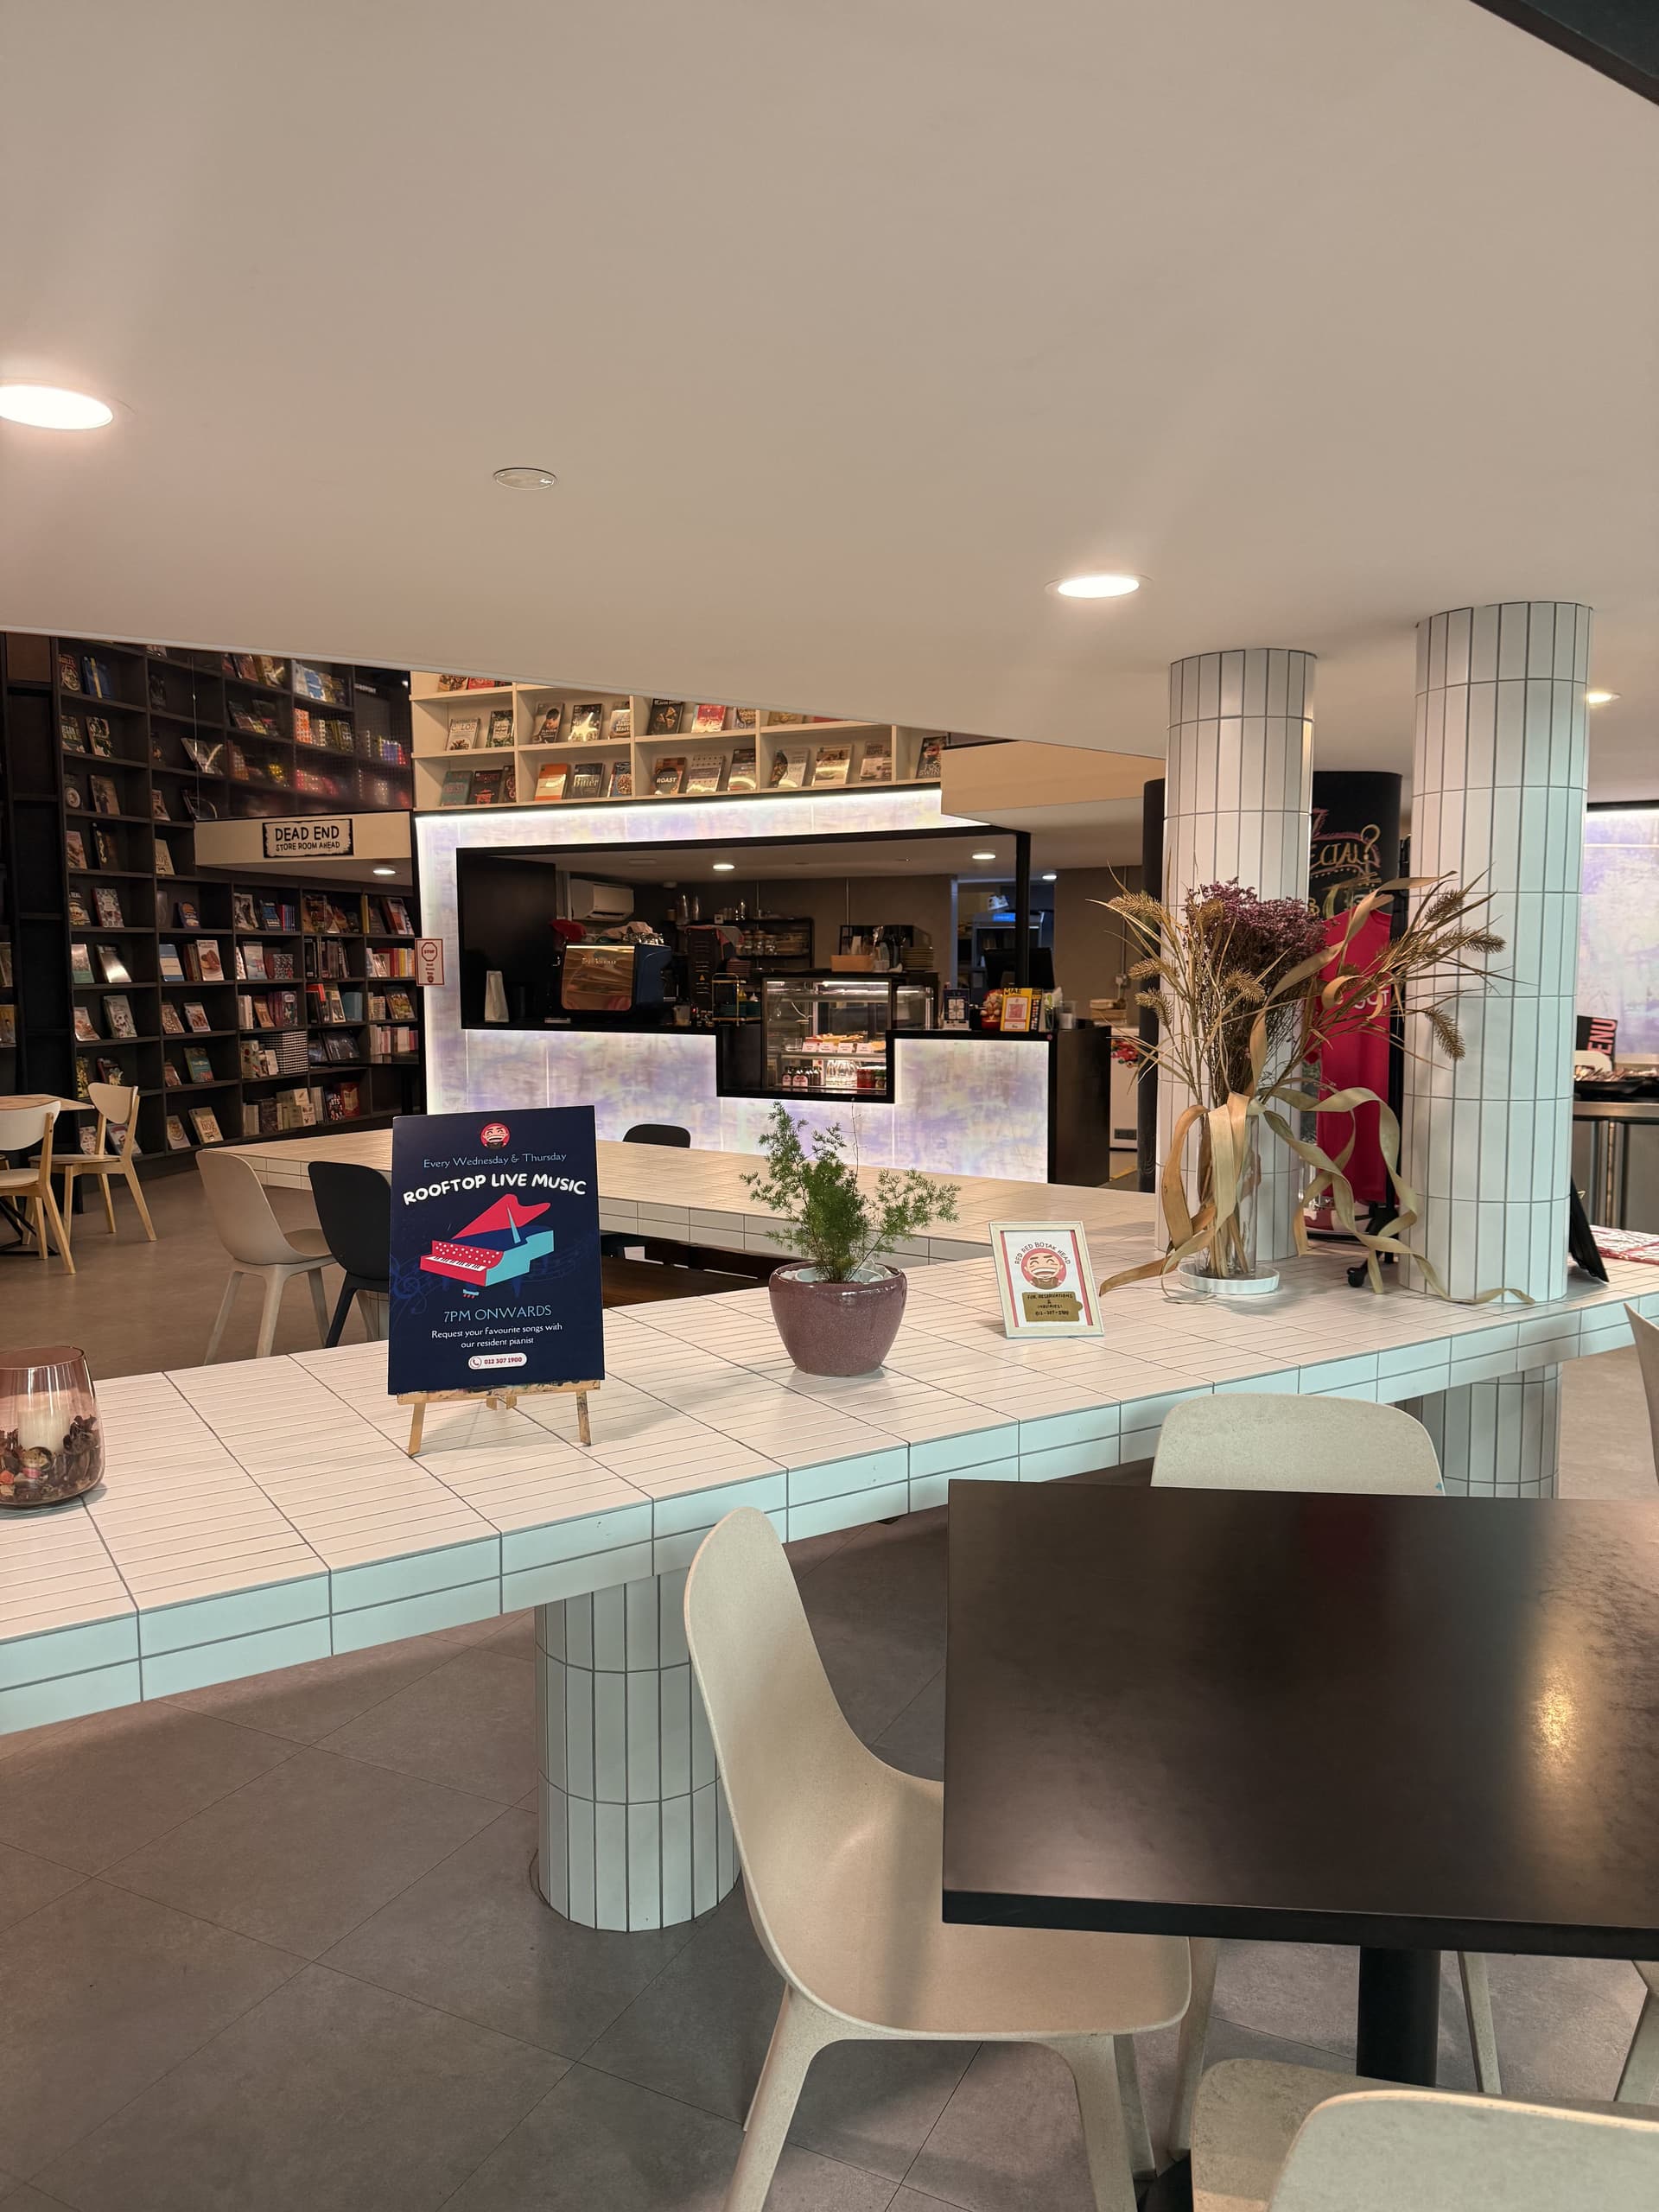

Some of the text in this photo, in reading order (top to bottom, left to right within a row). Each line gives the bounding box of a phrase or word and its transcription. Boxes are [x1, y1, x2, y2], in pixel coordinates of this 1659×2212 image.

[275, 825, 340, 842] DEAD END
[276, 841, 340, 852] STORE ROOM AHEAD
[423, 1152, 567, 1169] Every Wednesday & Thursday
[403, 1173, 587, 1205] ROOFTOP LIVE MUSIC
[1014, 1242, 1071, 1265] RED RED BOTAK HEAD
[444, 1305, 552, 1323] 7PM ONWARDS
[431, 1330, 463, 1339] Request
[485, 1325, 521, 1335] favourite
[522, 1325, 544, 1333] songs
[544, 1322, 563, 1331] with
[477, 1338, 507, 1347] resident
[509, 1336, 534, 1346] pianist
